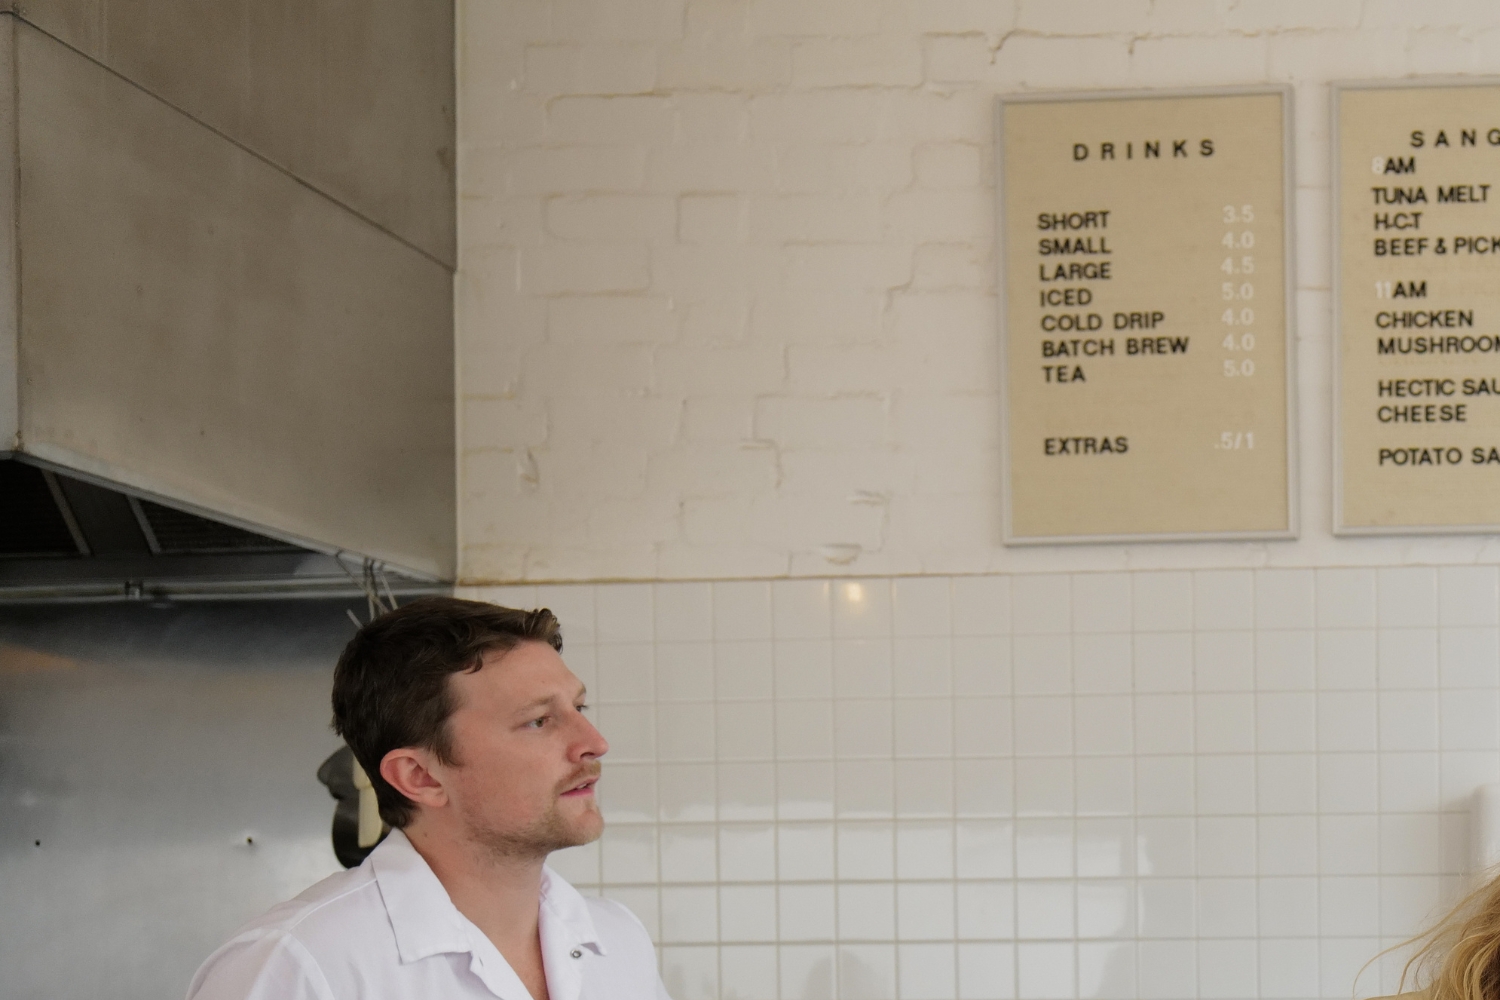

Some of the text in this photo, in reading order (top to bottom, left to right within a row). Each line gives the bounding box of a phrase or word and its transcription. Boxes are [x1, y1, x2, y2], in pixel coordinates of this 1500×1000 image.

[1072, 139, 1217, 162] DRINKS
[1371, 187, 1428, 206] TUNA
[1437, 184, 1492, 204] MELT
[1037, 205, 1255, 231] SHORT 3.5
[1037, 231, 1255, 256] SMALL 4.0
[1373, 238, 1429, 257] BEEF
[1433, 237, 1448, 257] &
[1039, 256, 1255, 282] LARGE 4.5
[1039, 282, 1255, 307] ICED 5.0
[1040, 308, 1255, 333] COLD DRIP 4.0
[1375, 310, 1474, 329] CHICKEN
[1041, 333, 1255, 358] BATCH BREW 4.0
[1042, 359, 1255, 384] TEA 5.0
[1377, 378, 1456, 398] HECTIC
[1377, 403, 1468, 424] CHEESE
[1044, 436, 1129, 457] EXTRAS
[1378, 446, 1463, 467] POTATO
